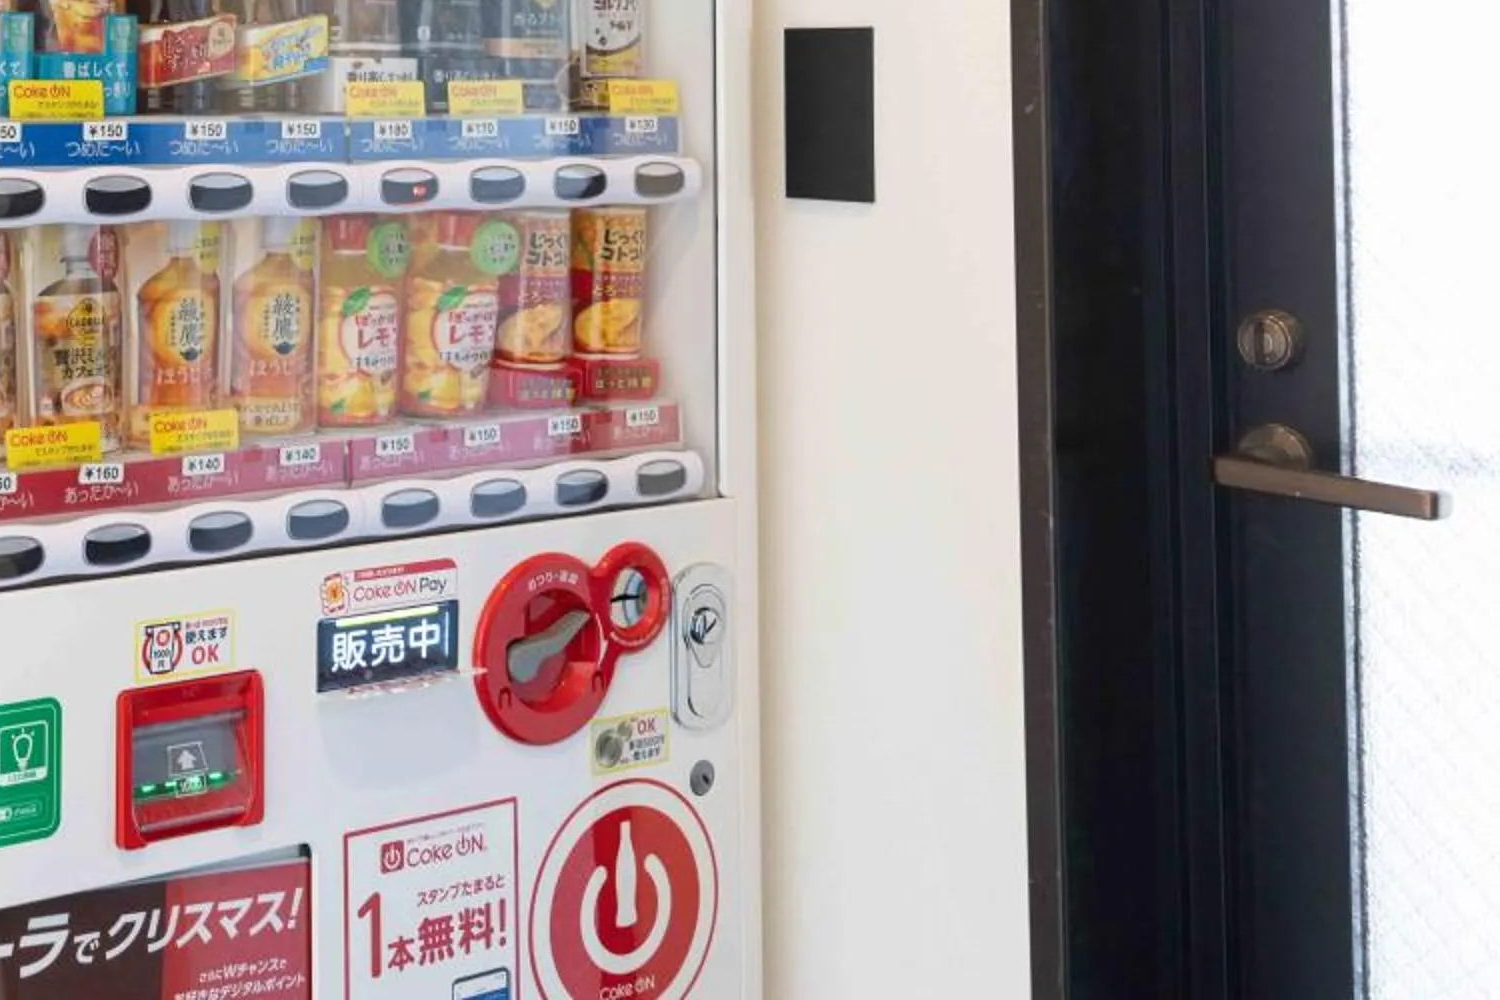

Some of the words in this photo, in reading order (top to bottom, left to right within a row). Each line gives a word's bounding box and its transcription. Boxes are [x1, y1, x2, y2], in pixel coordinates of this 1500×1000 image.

[88, 124, 123, 137] ¥150
[190, 124, 223, 137] ¥150
[287, 123, 317, 136] ¥150
[84, 466, 120, 481] ¥160
[187, 457, 221, 471] ¥140
[353, 583, 392, 602] Coke
[418, 576, 448, 595] Pay
[191, 643, 219, 665] OK
[331, 618, 441, 673] 販売中
[637, 716, 656, 736] OK
[406, 842, 453, 867] Coke
[455, 832, 485, 857] ON
[416, 873, 506, 908] スタンプたまると
[357, 890, 507, 979] 1本無料!
